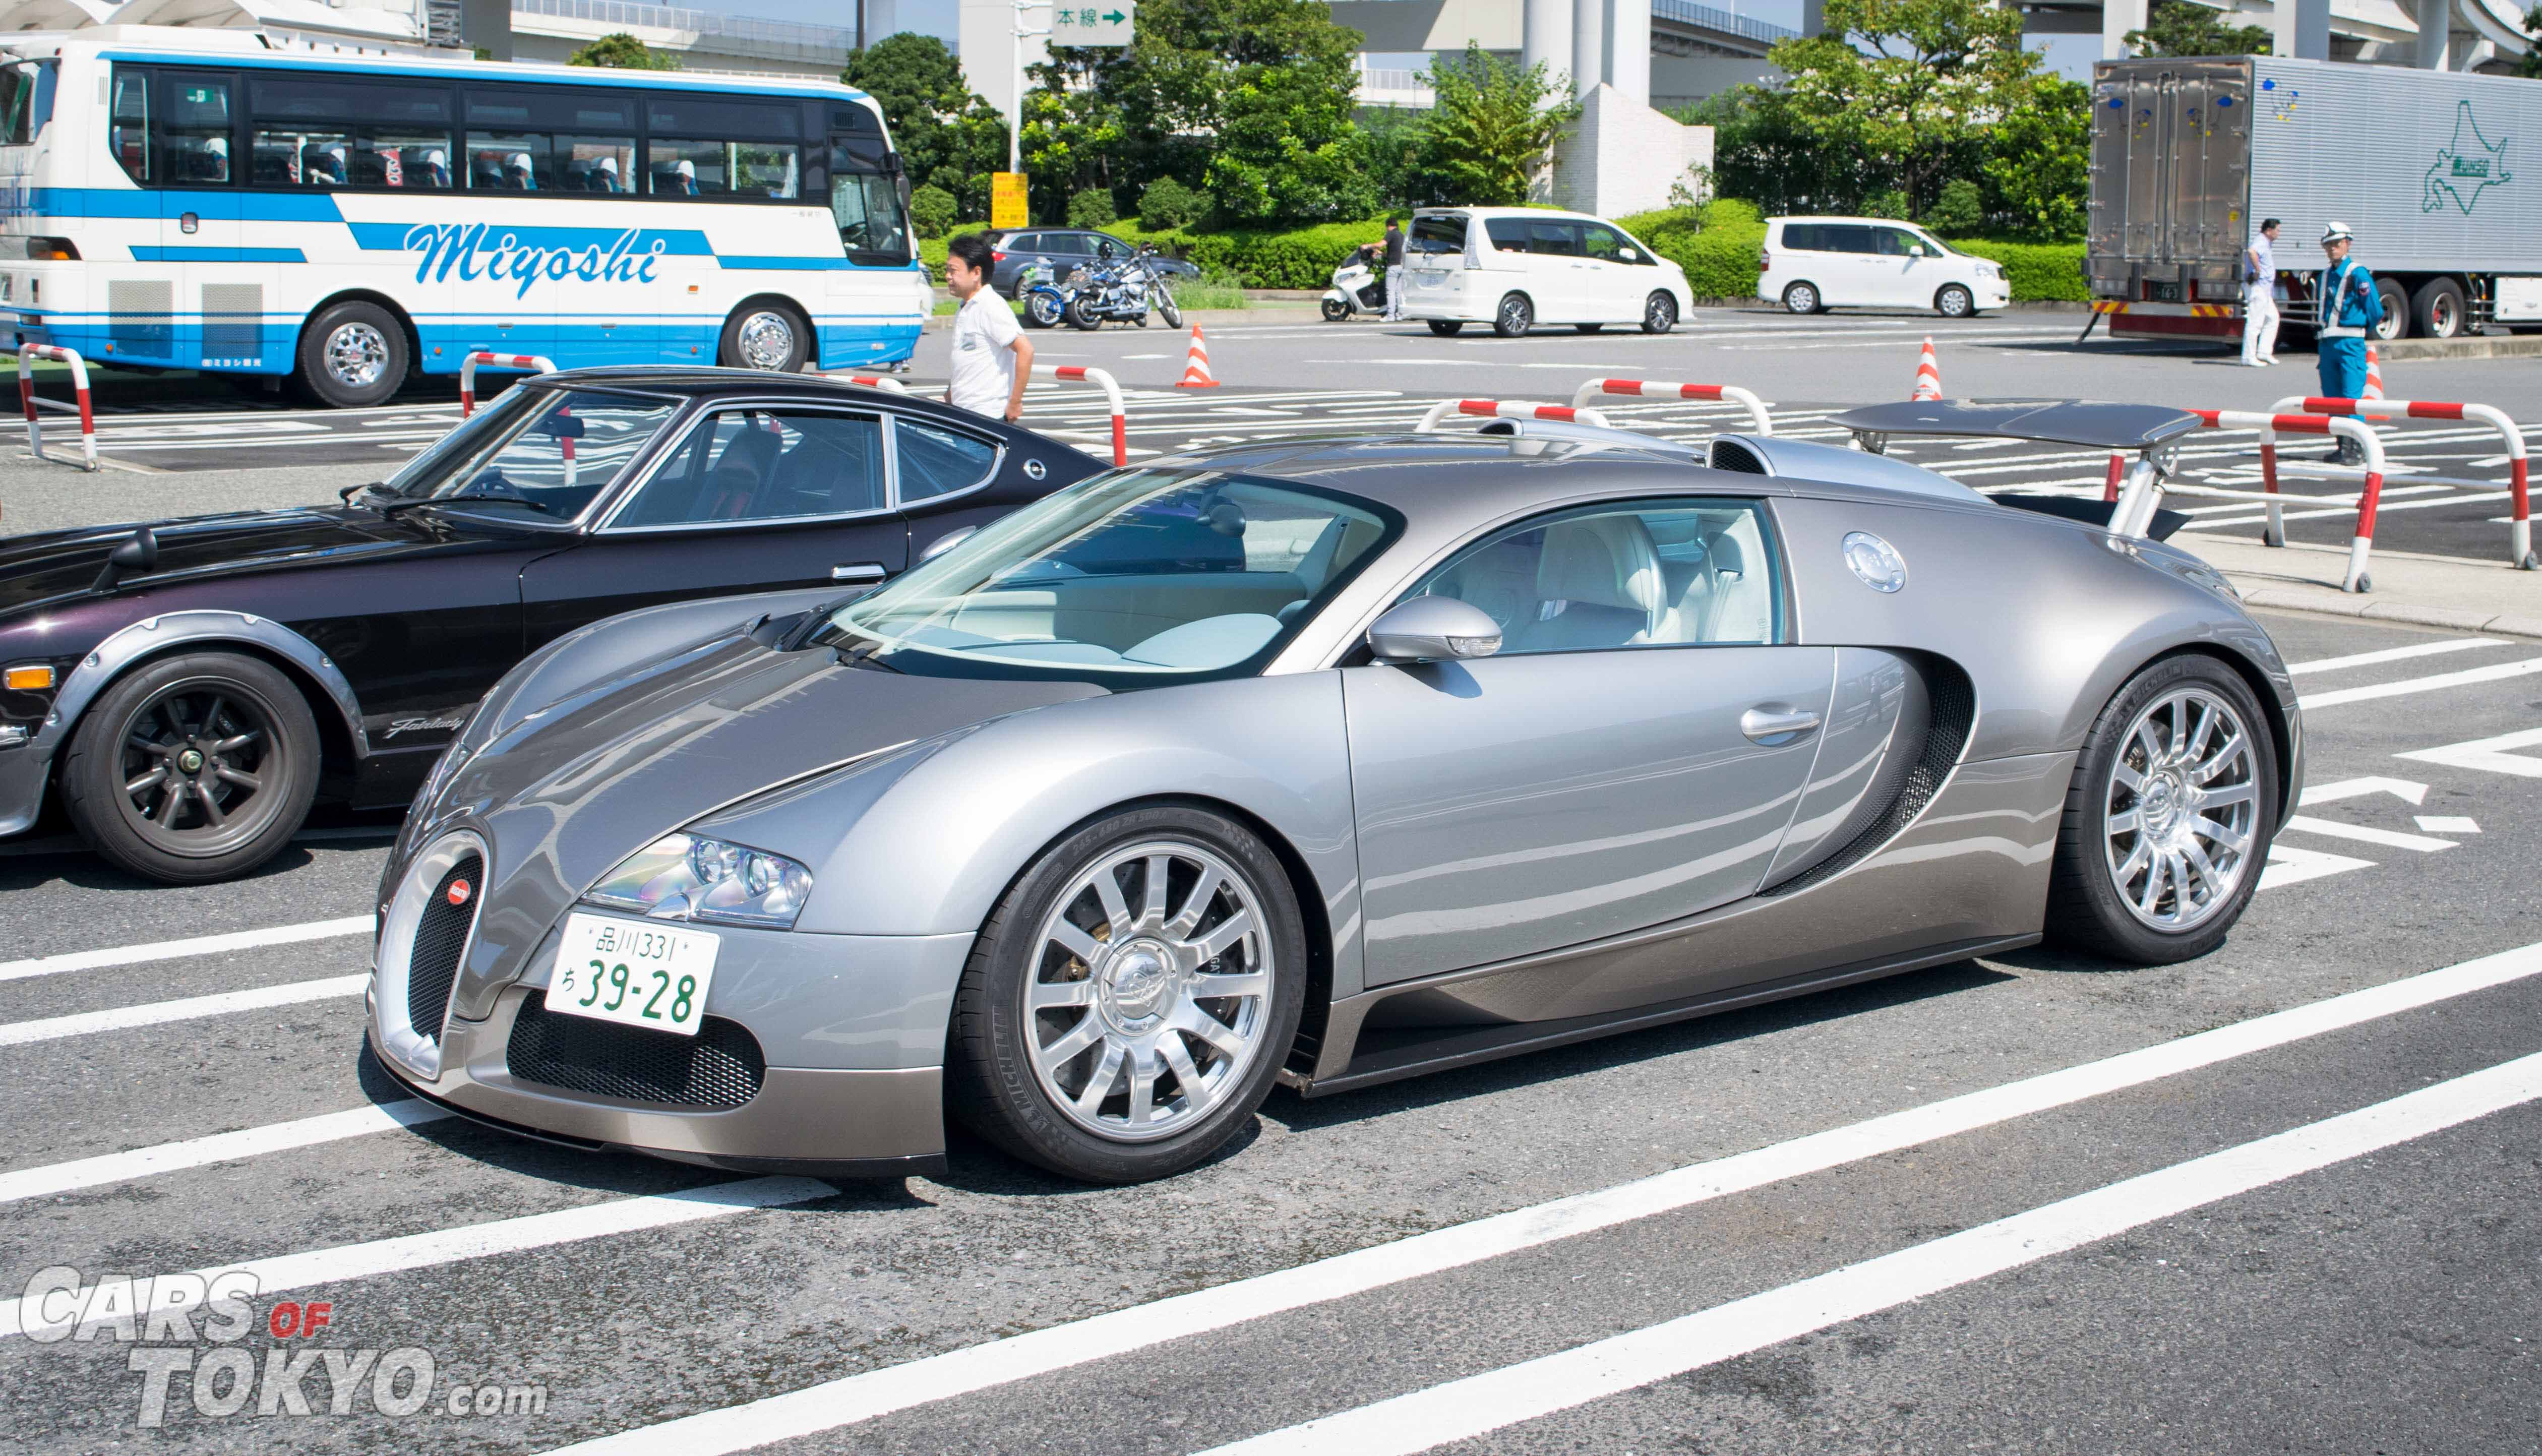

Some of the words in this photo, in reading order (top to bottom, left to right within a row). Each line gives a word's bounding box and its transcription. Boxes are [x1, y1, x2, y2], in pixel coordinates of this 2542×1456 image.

[1057, 8, 1097, 27] 本線
[404, 222, 665, 300] Miyoshi
[382, 717, 465, 739] Fairlady
[562, 967, 575, 992] ち
[578, 959, 697, 1023] 39-28
[992, 1004, 1034, 1110] MICHELIN
